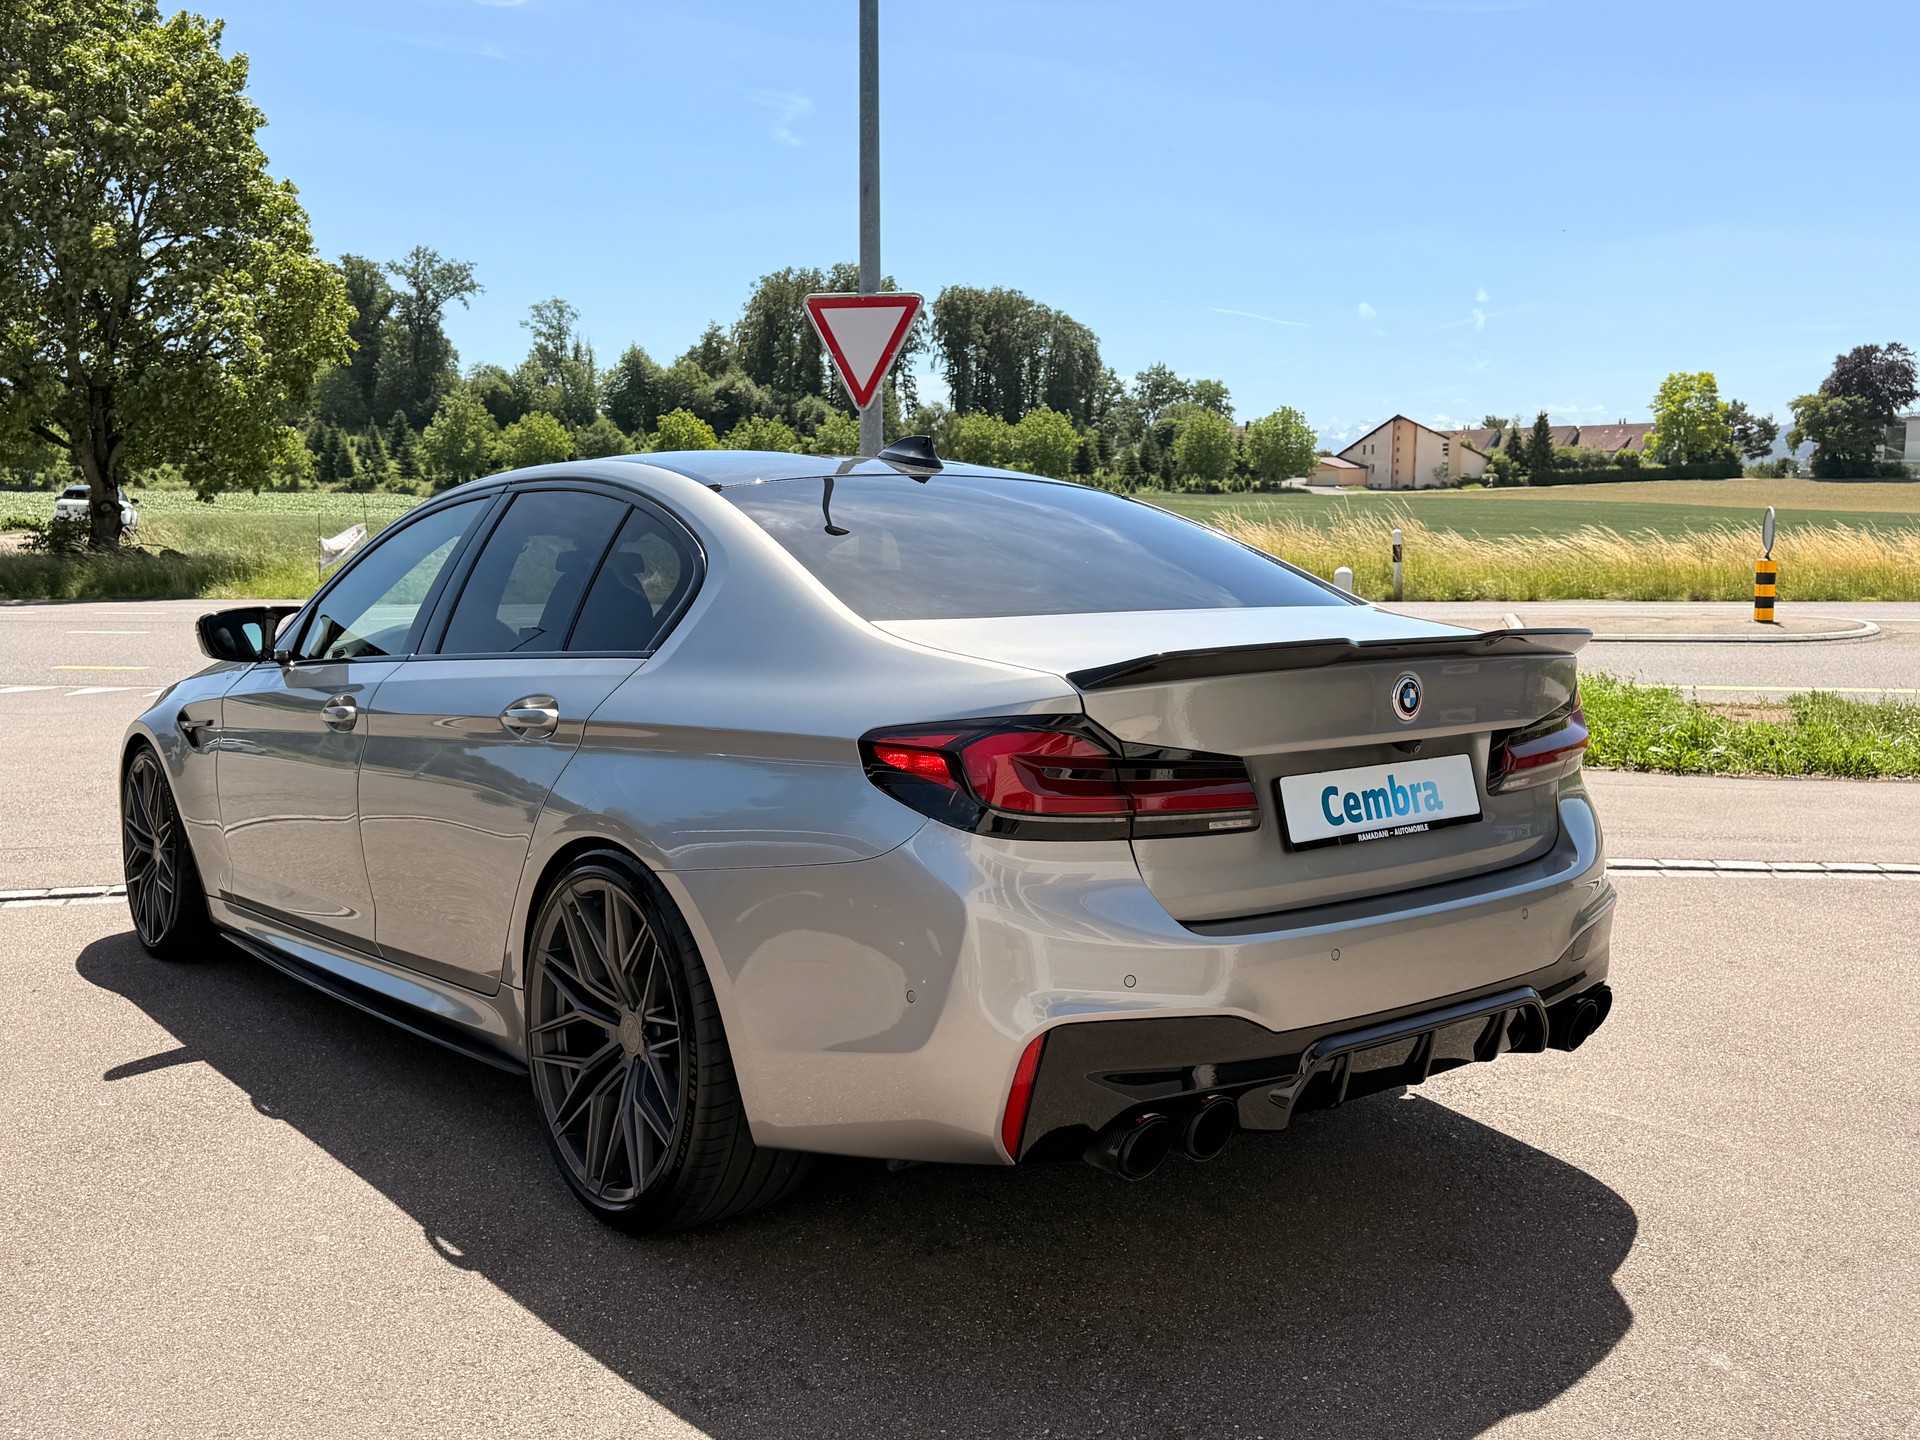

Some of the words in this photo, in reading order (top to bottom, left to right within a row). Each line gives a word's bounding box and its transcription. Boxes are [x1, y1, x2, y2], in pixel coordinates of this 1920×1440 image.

[1321, 774, 1443, 826] Cembra
[1357, 829, 1390, 842] RAMADANI
[1394, 823, 1430, 836] AUTOMOBILE
